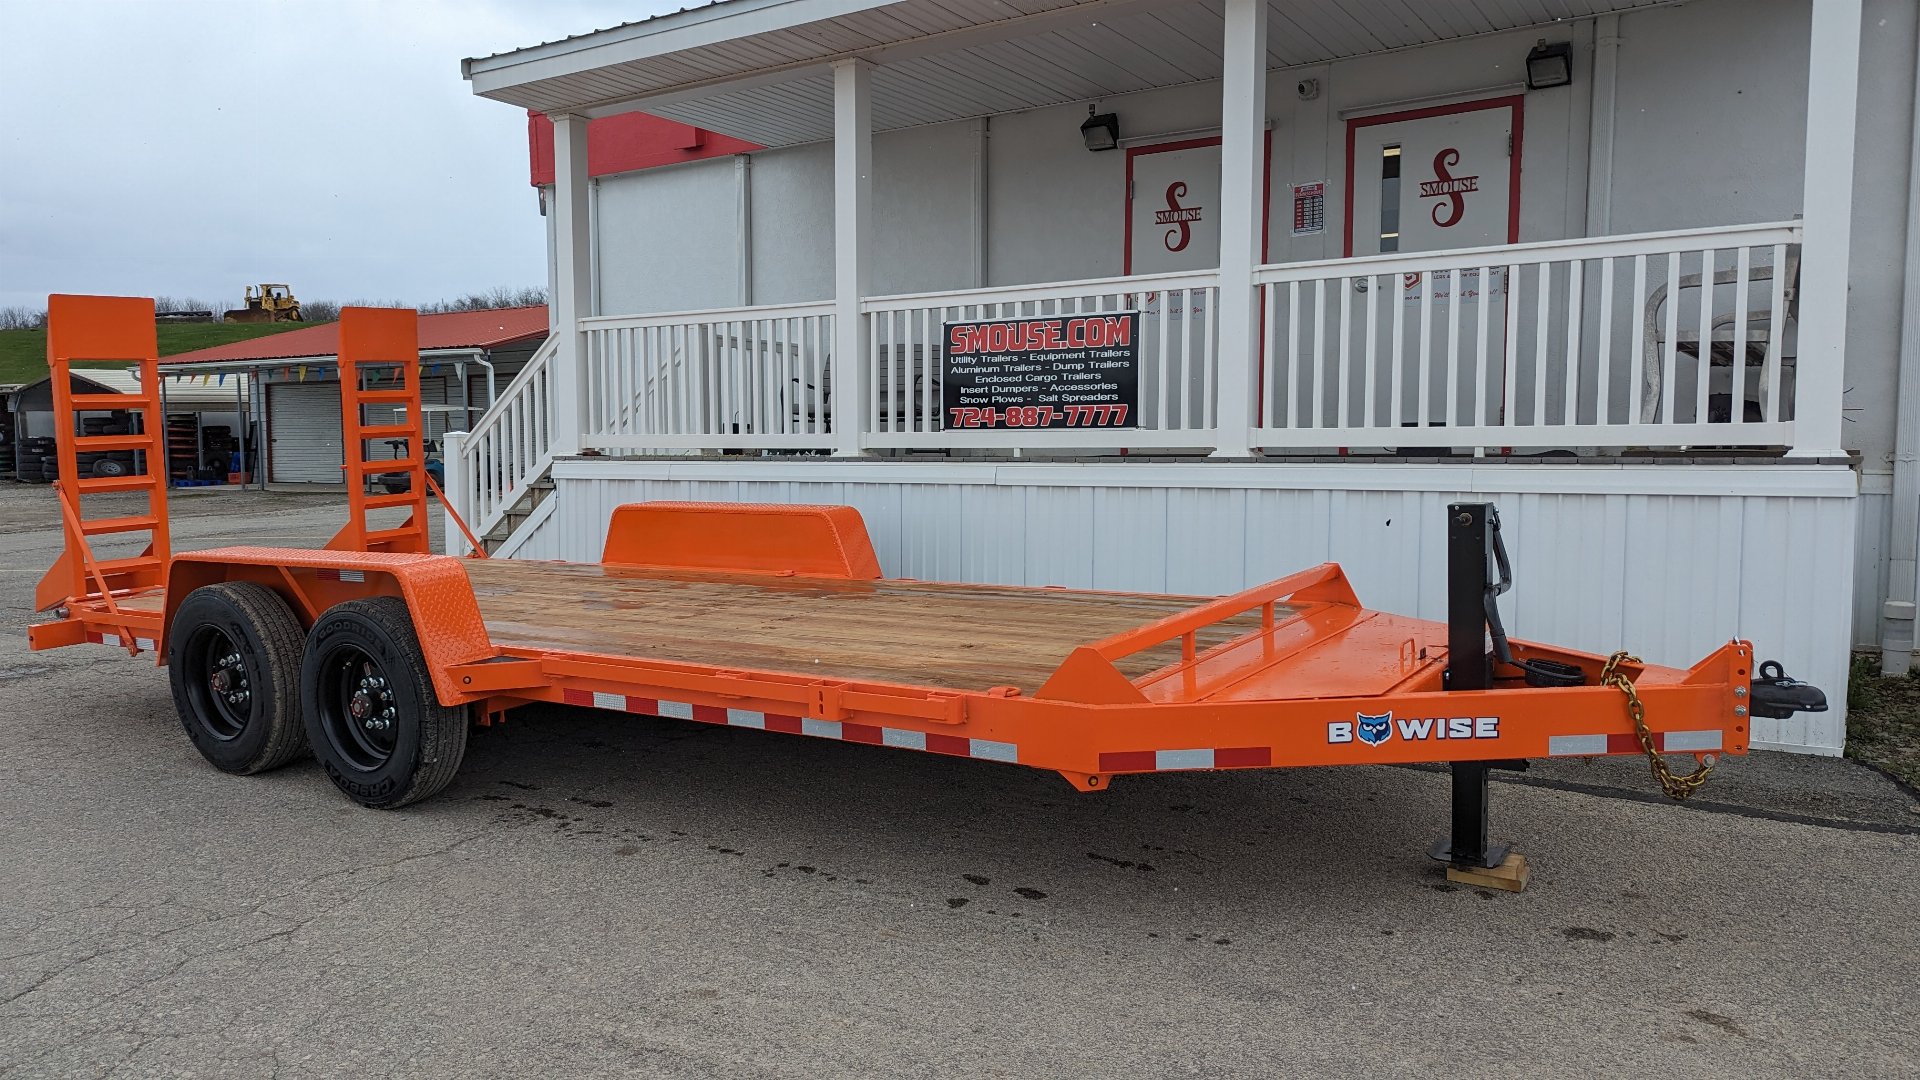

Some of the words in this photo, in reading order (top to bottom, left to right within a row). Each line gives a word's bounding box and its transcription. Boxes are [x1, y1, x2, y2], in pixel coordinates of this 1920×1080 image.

[1420, 176, 1479, 198] SMOUSE
[1155, 207, 1202, 224] SMOUSE
[950, 316, 1131, 354] SMOUSE.COM
[950, 355, 977, 365] Utility
[980, 354, 1018, 363] Trailers
[1029, 351, 1085, 362] Equipment
[1088, 349, 1131, 358] Trailers
[950, 366, 1000, 374] Aluminum
[1003, 364, 1042, 372] Trailers
[1053, 362, 1085, 371] Dump
[1088, 360, 1130, 369] Trailers
[975, 374, 1022, 384] Enclosed
[1025, 373, 1058, 383] Cargo
[1061, 372, 1102, 381] Trailers
[960, 386, 989, 394] Insert
[991, 385, 1039, 394] Dumpers
[1049, 382, 1118, 392] Accessories
[960, 396, 989, 404] Snow
[991, 395, 1024, 403] Plows
[1038, 394, 1058, 402] Salt
[1061, 393, 1119, 403] Spreaders
[950, 404, 1129, 428] 724-887-7777
